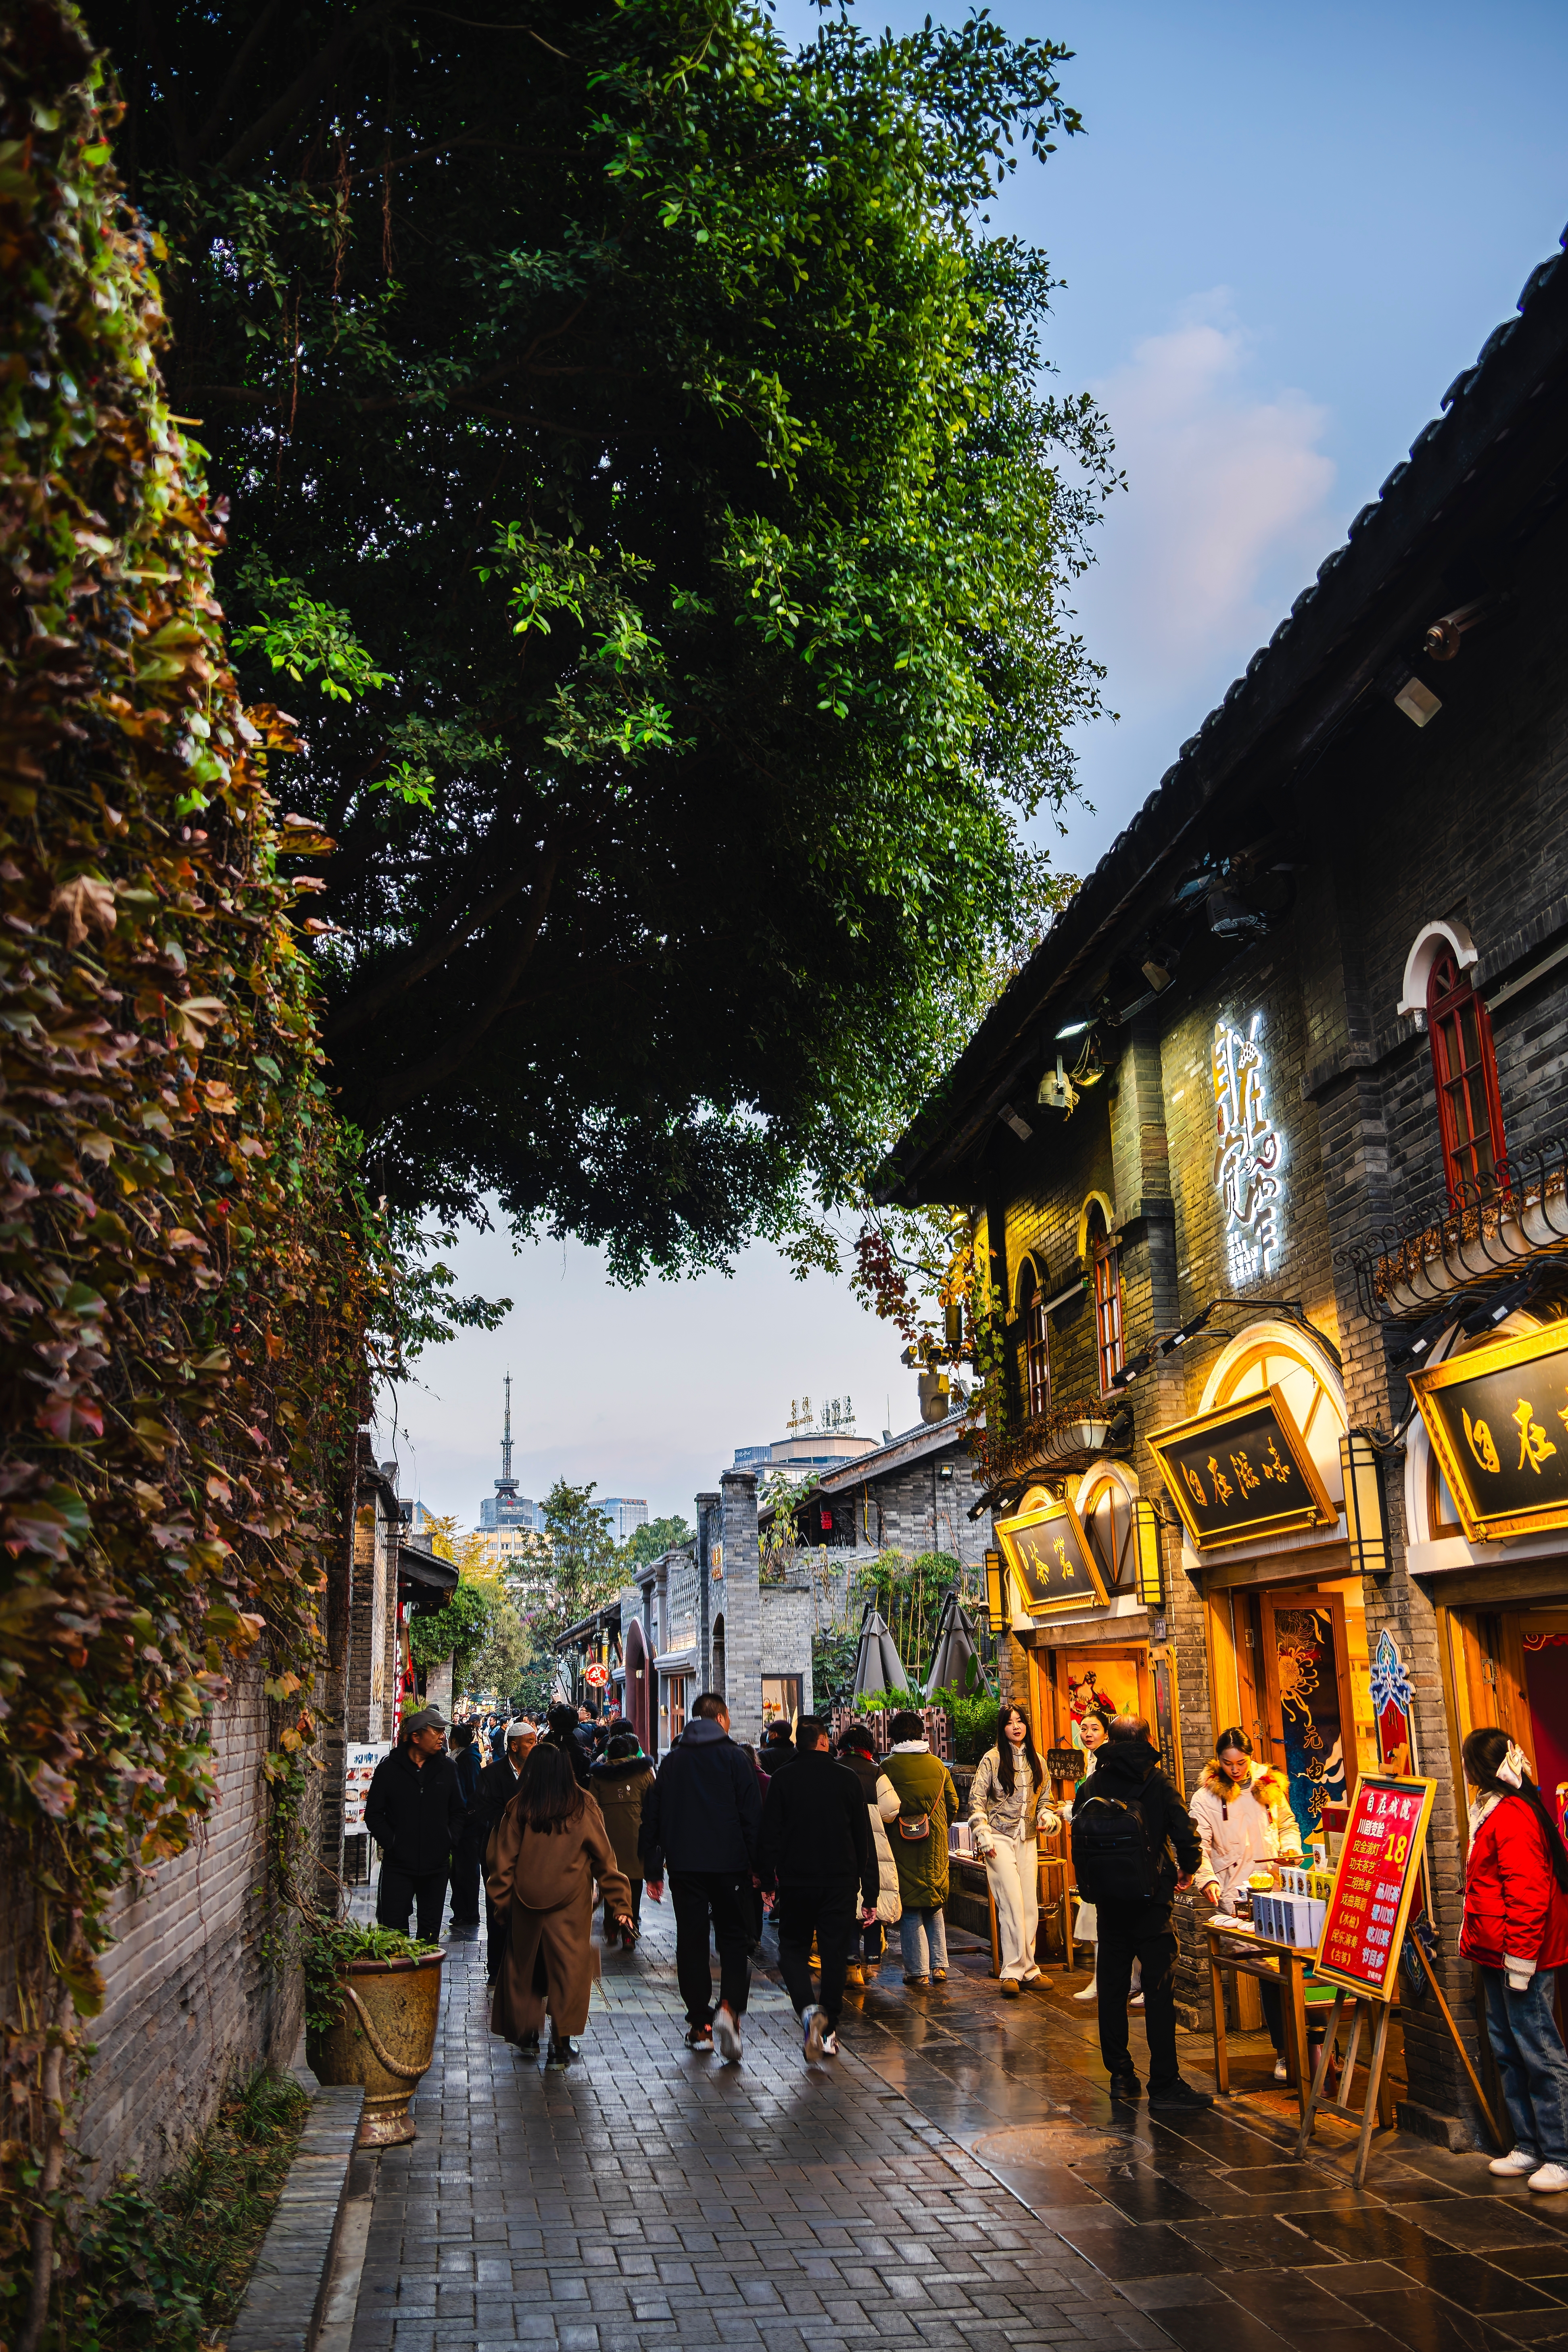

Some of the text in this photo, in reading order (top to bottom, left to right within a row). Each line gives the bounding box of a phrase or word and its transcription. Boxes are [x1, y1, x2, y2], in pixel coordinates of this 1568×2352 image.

[1226, 1230, 1240, 1247] ZI
[1227, 1239, 1248, 1259] ZAI
[1229, 1245, 1259, 1271] KUAN
[786, 1415, 814, 1428] JINHE HOTEL
[1462, 1386, 1568, 1474] 自在
[1366, 1792, 1412, 1820] 自在戏院
[1357, 1818, 1385, 1838] 川剧变脸
[1352, 1839, 1381, 1856] 皮金滚灯
[1384, 1833, 1407, 1864] 18
[1349, 1857, 1376, 1874] 功夫茶艺
[1345, 1876, 1372, 1893] 二胡独奏
[1340, 1893, 1368, 1912] 戏曲舞蹈
[1330, 1928, 1359, 1949] 民乐演奏
